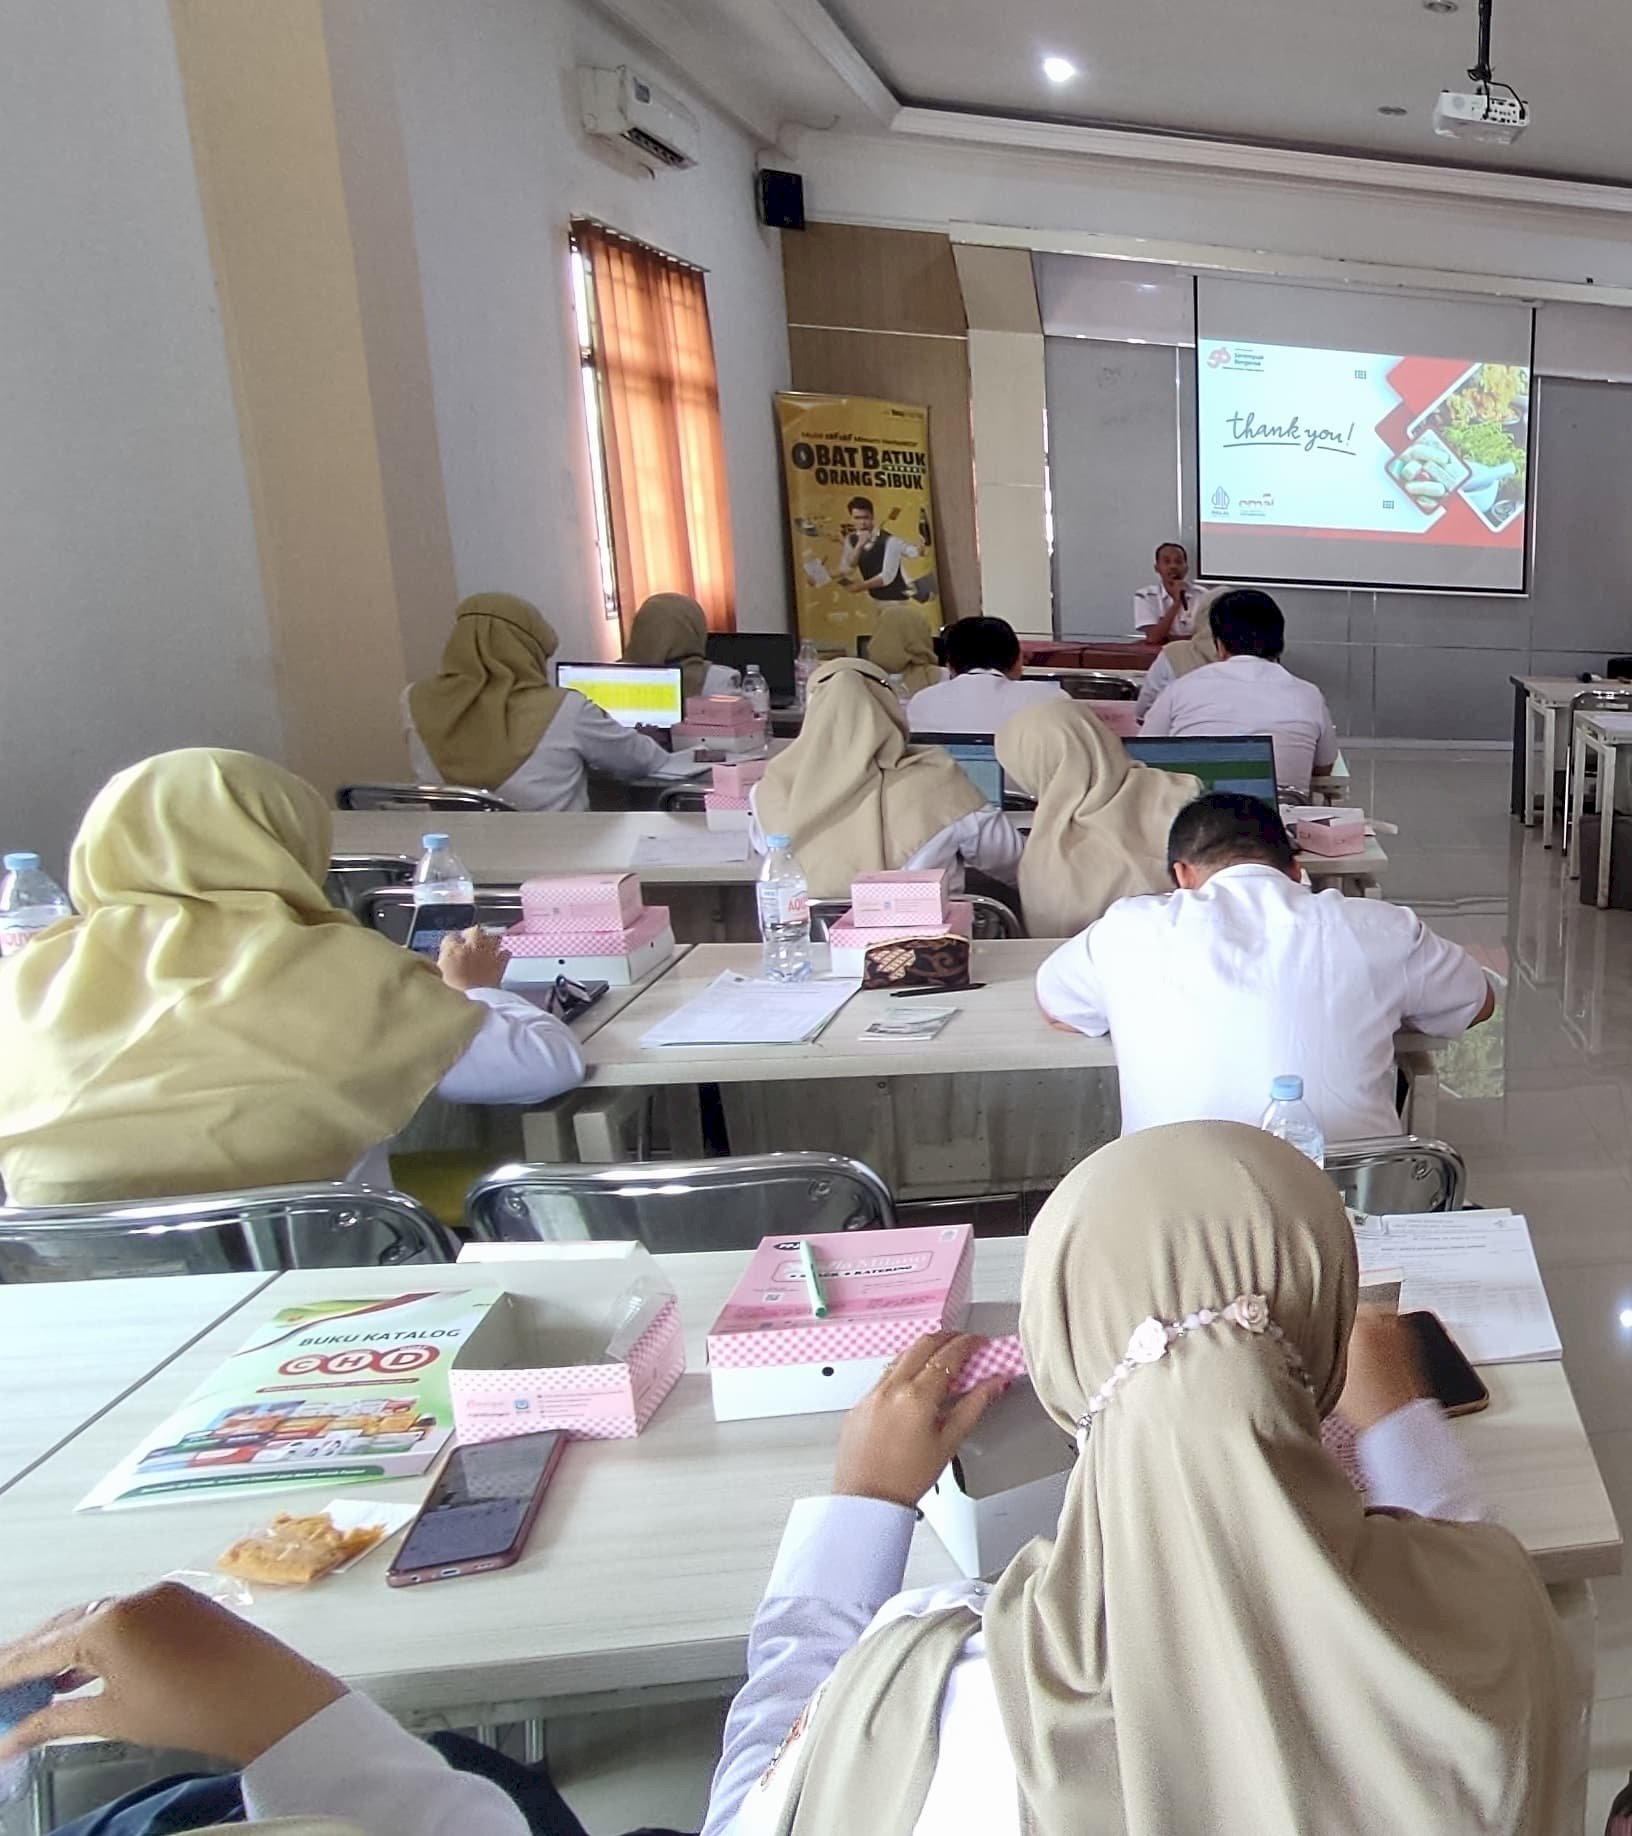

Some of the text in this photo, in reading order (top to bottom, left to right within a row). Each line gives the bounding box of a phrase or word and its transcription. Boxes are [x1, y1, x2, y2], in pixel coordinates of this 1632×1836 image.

[1226, 411, 1355, 452] thank you!
[792, 442, 926, 470] OBAT BATUK
[815, 468, 873, 487] ORANG
[874, 471, 924, 490] SIBUK
[299, 1328, 461, 1346] BUKU KATALOG
[290, 1350, 430, 1373] CHD
